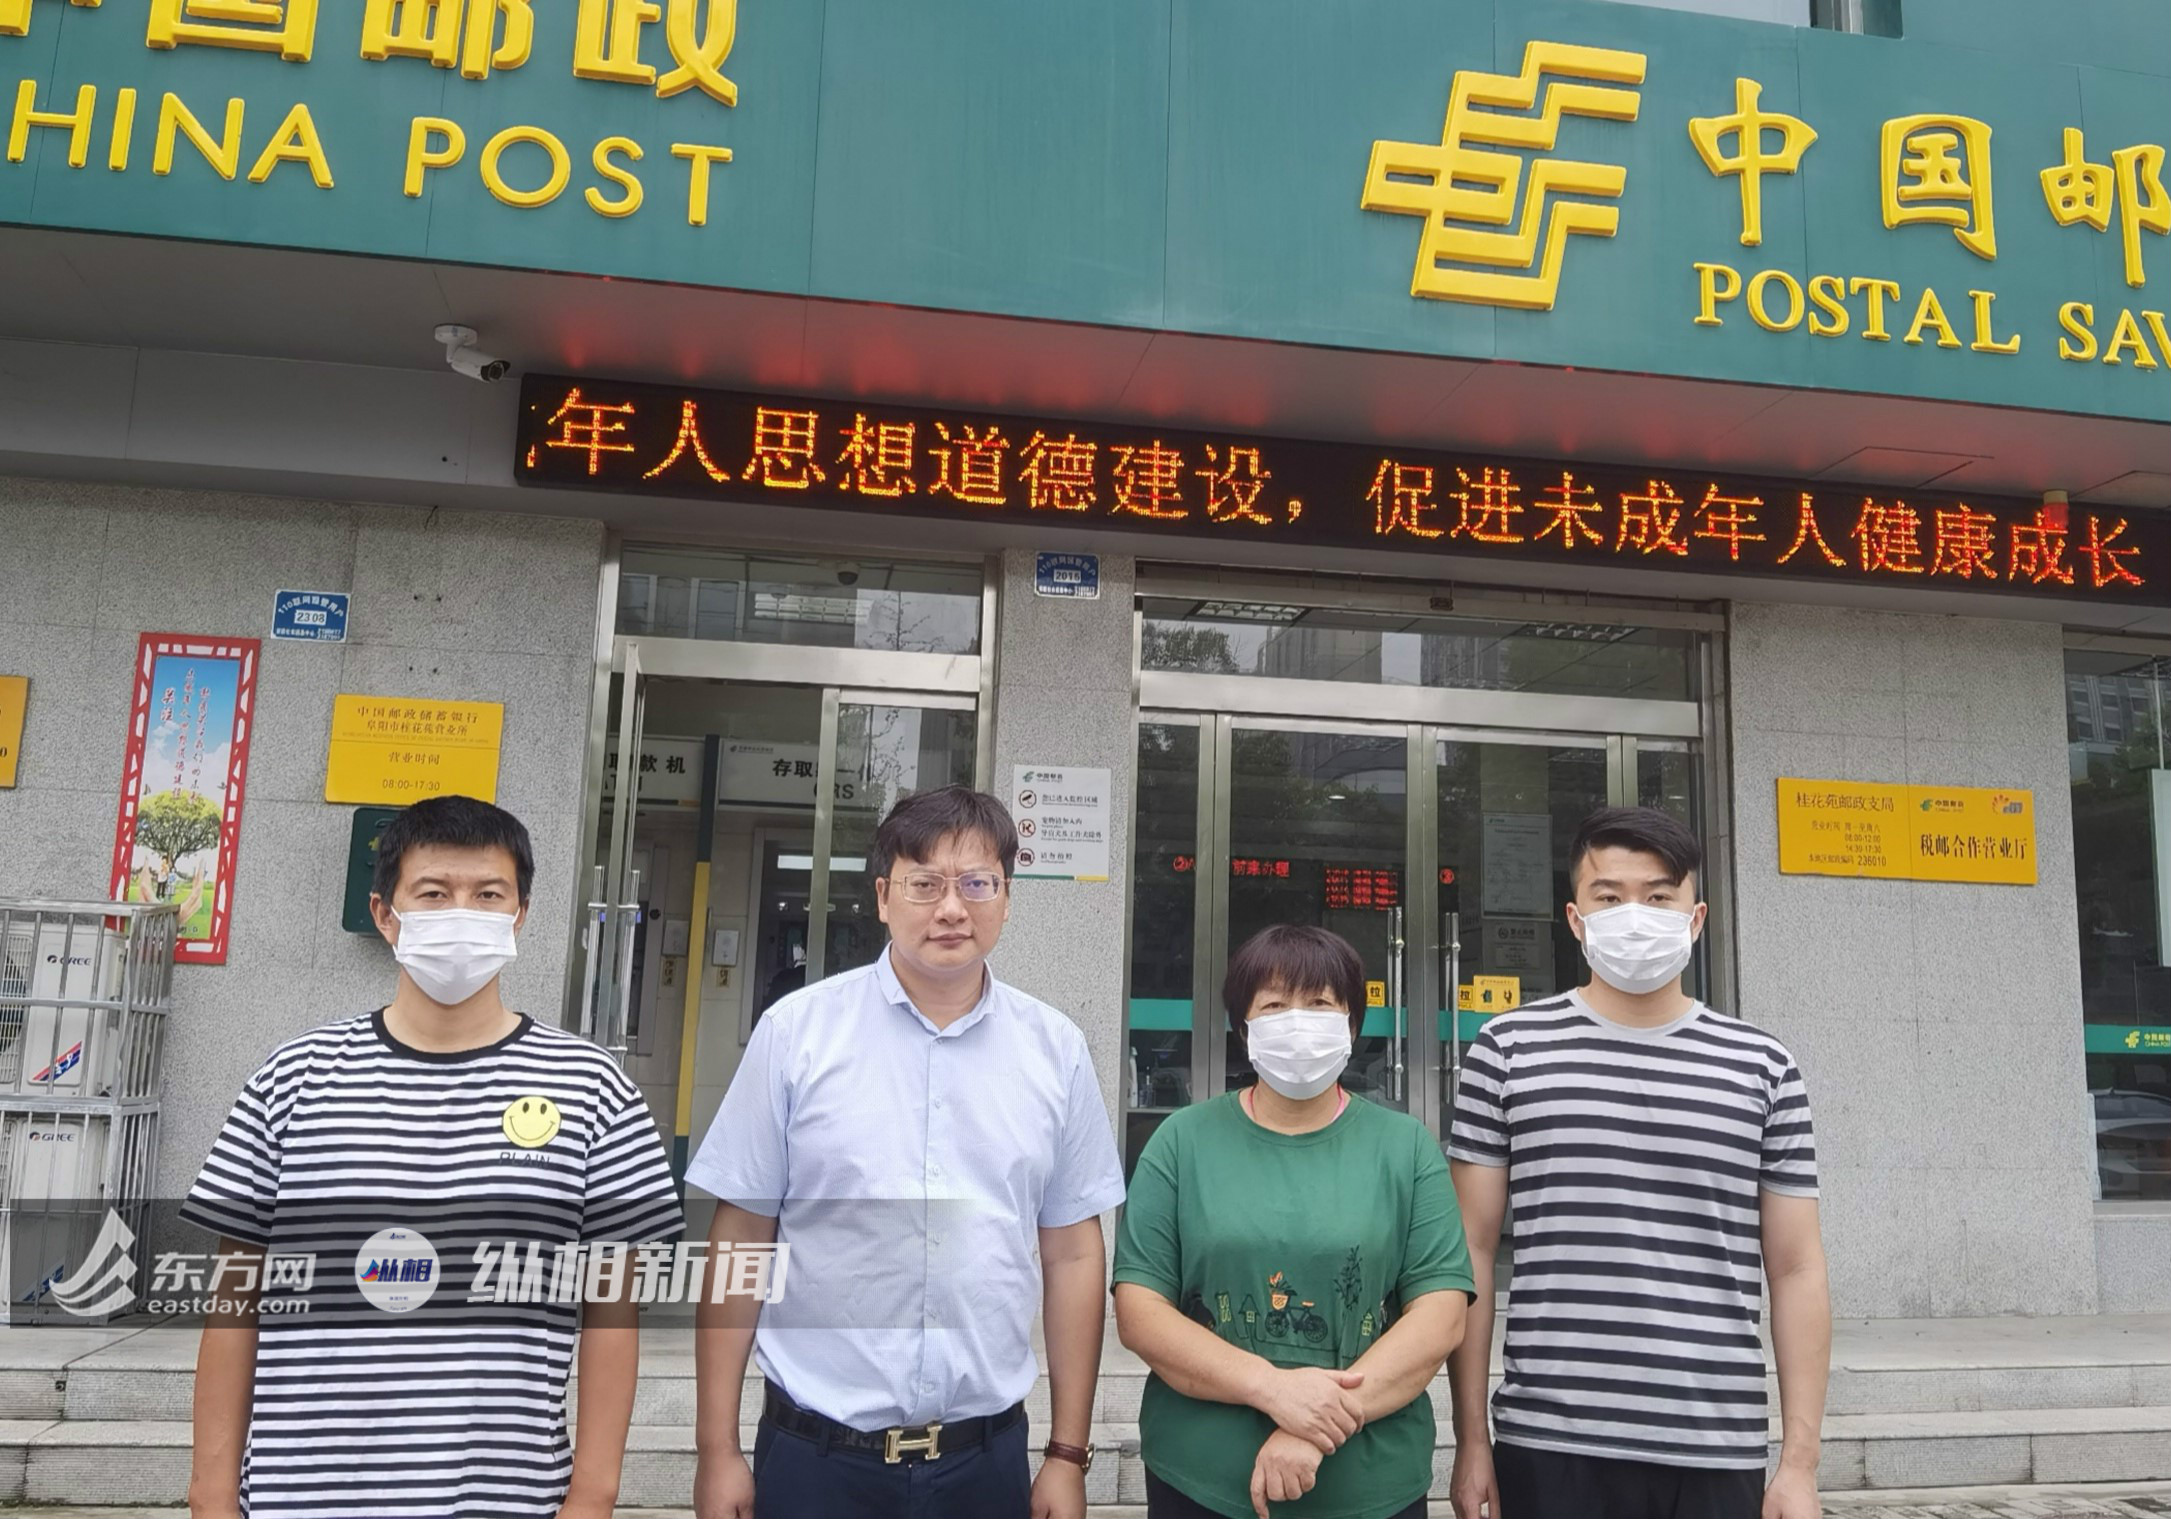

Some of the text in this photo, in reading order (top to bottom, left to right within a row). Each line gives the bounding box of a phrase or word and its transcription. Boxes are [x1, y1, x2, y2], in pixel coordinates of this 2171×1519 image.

[8, 80, 733, 225] HINA POST
[1689, 78, 2171, 287] 中国邮
[1693, 262, 2020, 353] POSTAL
[527, 386, 2146, 588] 年人思想道德建设，促进未成年人健康成长
[296, 612, 325, 623] 2308
[357, 705, 478, 724] 中国邮政储蓄银行
[388, 751, 441, 766] 营业时间
[382, 778, 441, 792] 08:00-17:30
[813, 784, 855, 800] RS
[1796, 792, 1894, 812] 桂花苑邮政支局
[1920, 833, 2028, 860] 税邮合作营业厅
[1369, 986, 1381, 997] 拉
